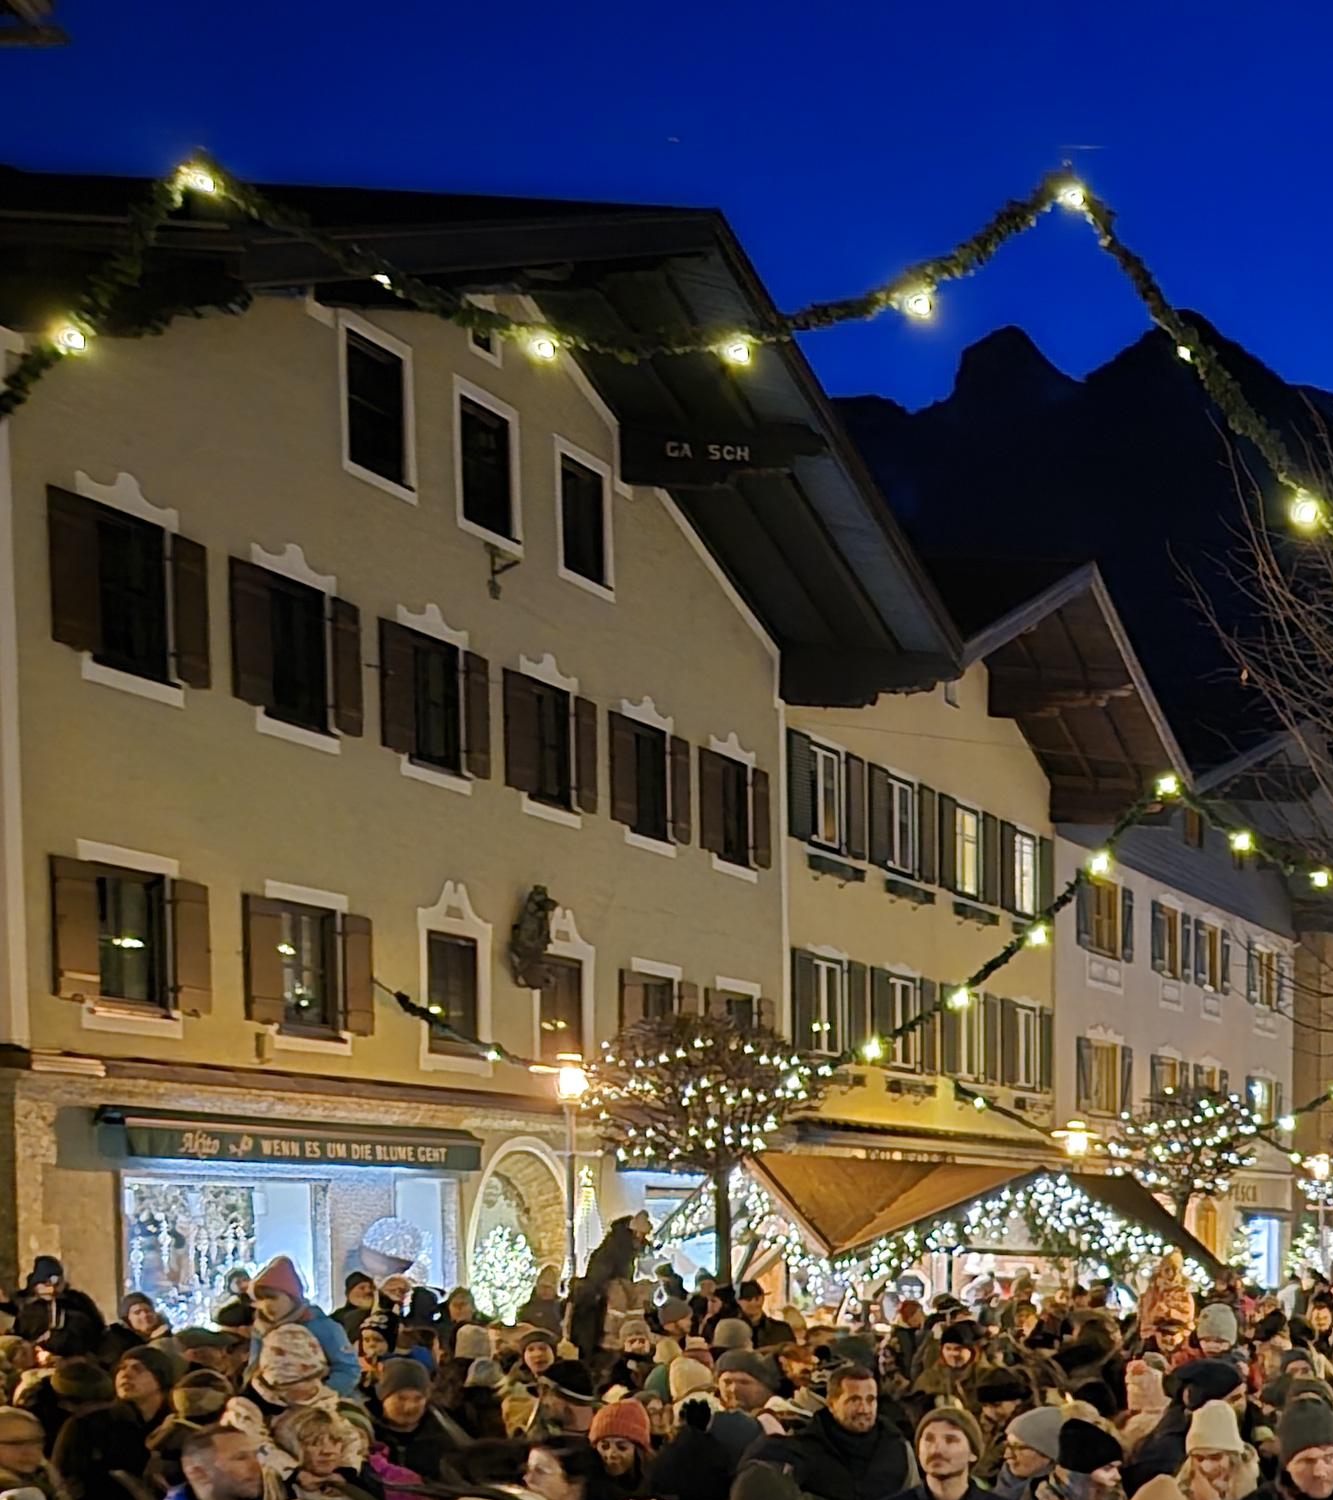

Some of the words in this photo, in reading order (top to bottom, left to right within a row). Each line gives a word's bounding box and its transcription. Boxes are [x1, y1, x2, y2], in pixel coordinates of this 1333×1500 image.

[261, 1139, 300, 1157] WENN
[305, 1141, 320, 1159] ES
[326, 1142, 347, 1159] UM
[351, 1143, 373, 1160] DIE
[375, 1144, 415, 1162] BLUME
[417, 1146, 447, 1163] GEHT
